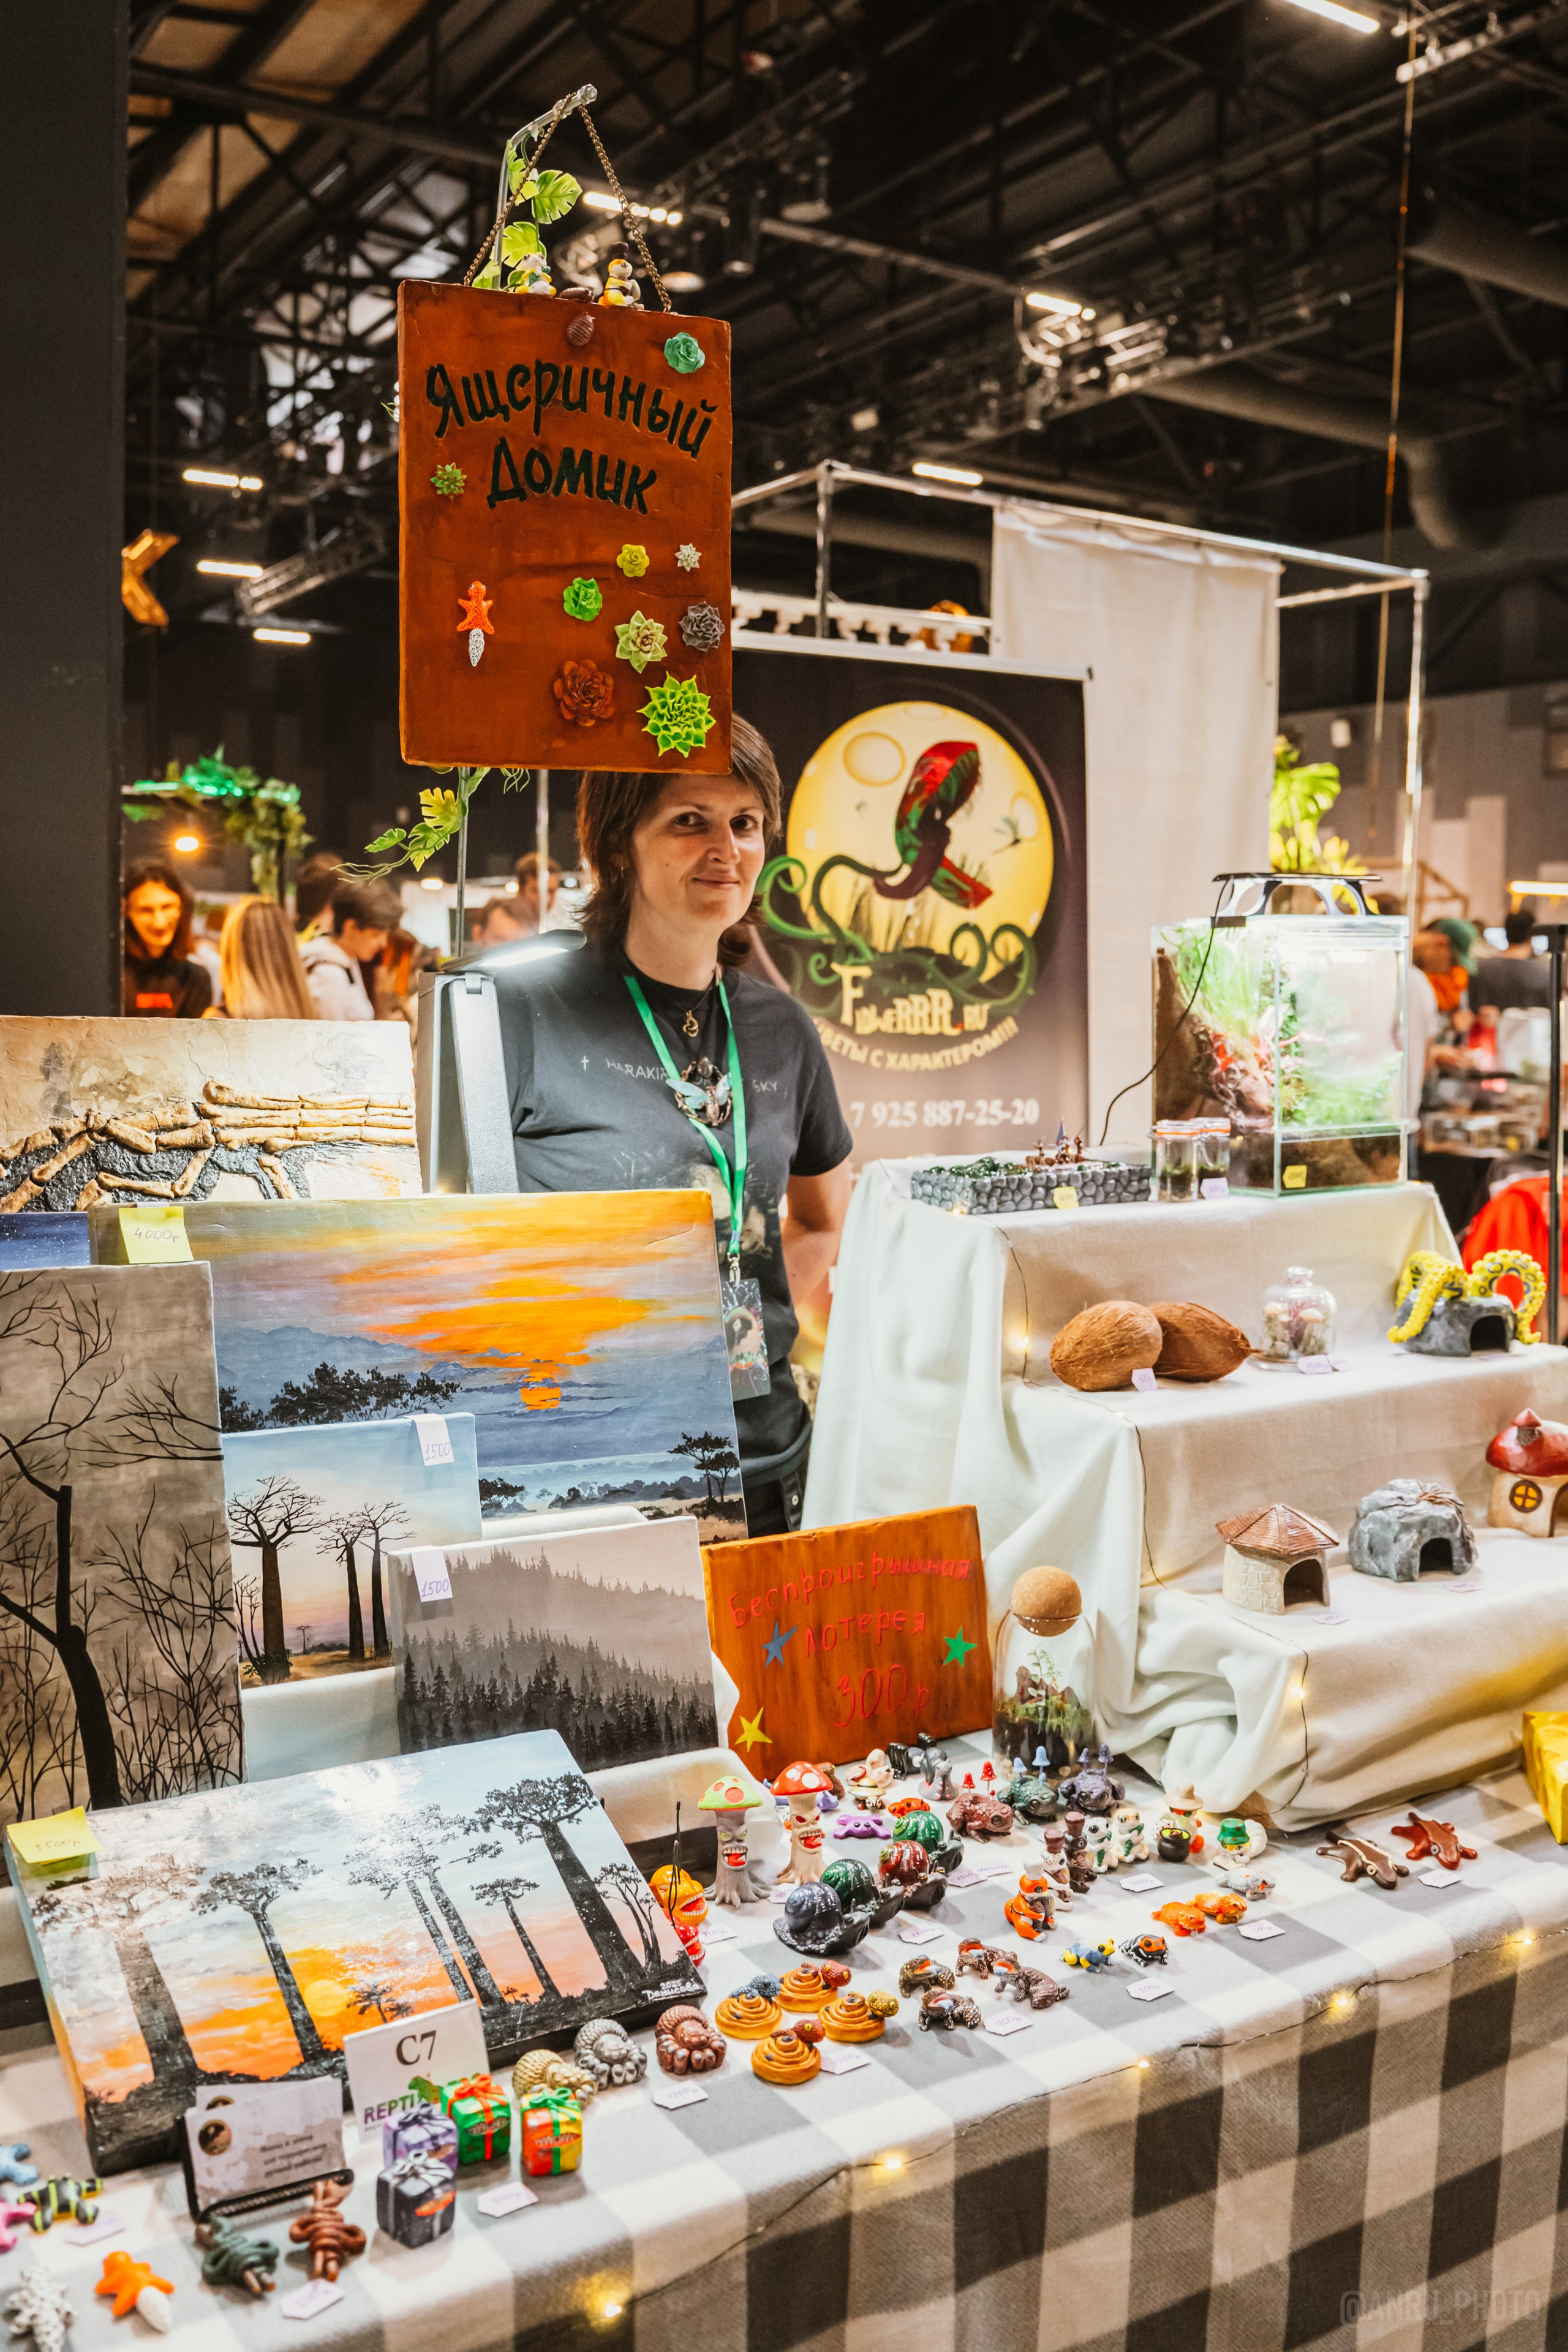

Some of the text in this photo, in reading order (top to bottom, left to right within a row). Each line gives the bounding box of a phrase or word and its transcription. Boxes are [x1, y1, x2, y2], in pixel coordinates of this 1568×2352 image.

[426, 358, 718, 459] Ящеричный
[487, 436, 657, 514] Домик
[606, 1058, 778, 1093] HARAKIR SKY
[871, 1100, 918, 1128] 925
[922, 1098, 1040, 1128] 887-25-20
[424, 1442, 451, 1461] 1500
[421, 1578, 449, 1598] 1500
[727, 1550, 971, 1629] Беспроигрышная
[396, 2029, 437, 2066] C7
